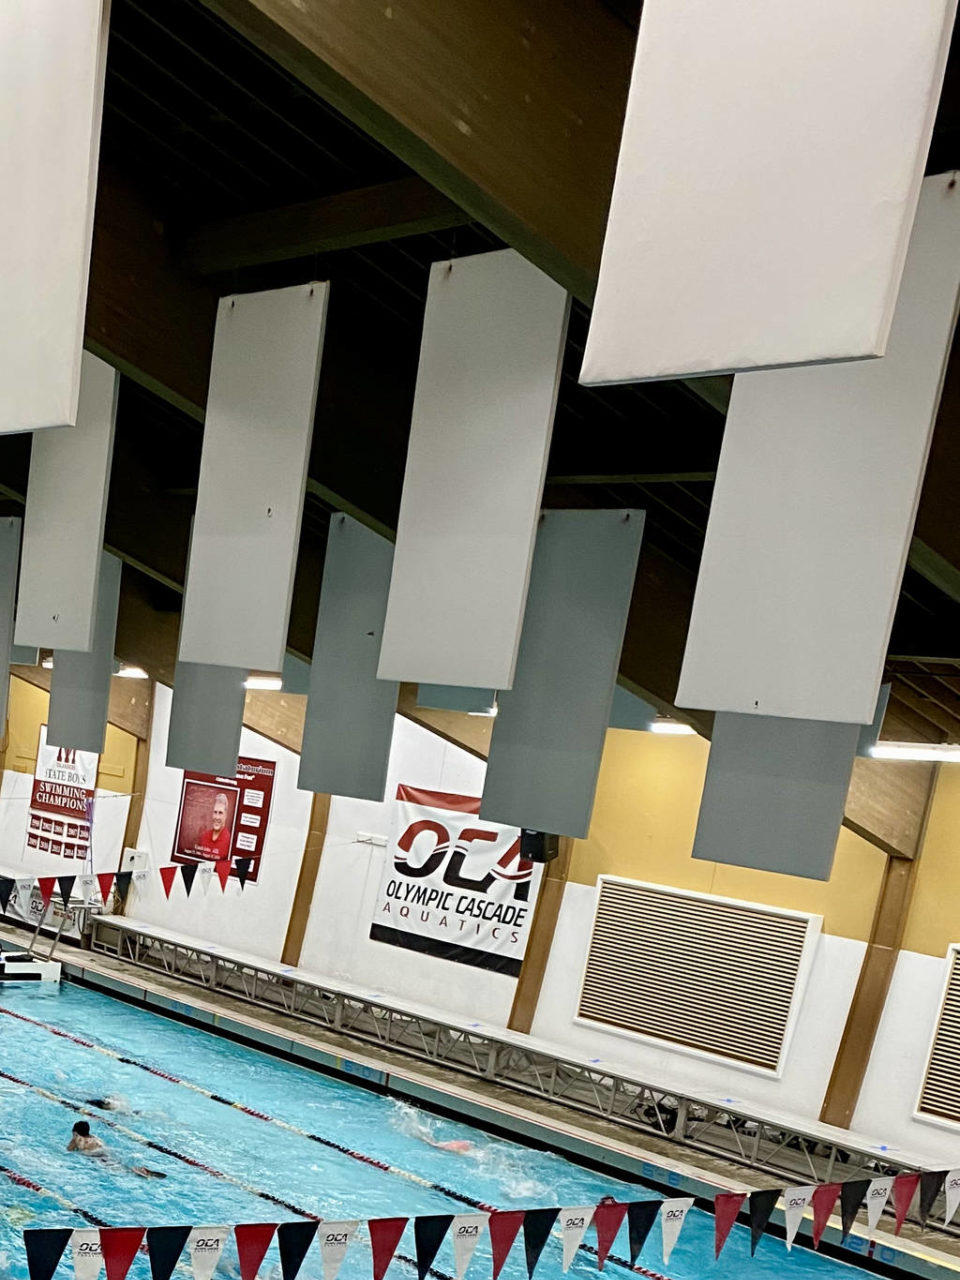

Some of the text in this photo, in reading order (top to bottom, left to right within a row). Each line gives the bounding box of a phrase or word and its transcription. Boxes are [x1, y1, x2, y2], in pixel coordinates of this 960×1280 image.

[45, 768, 87, 785] STATE BOYS
[40, 782, 86, 799] SWIMMING
[36, 792, 87, 812] CHAMPIONS
[394, 820, 534, 902] OCA
[386, 880, 528, 928] OLYMPIC CASCADE
[382, 902, 519, 943] AQUATICS
[566, 1218, 585, 1226] OCA
[666, 1210, 683, 1218] OCA
[326, 1234, 348, 1242] OCA
[458, 1226, 479, 1234] OCA
[196, 1239, 220, 1247] OCA
